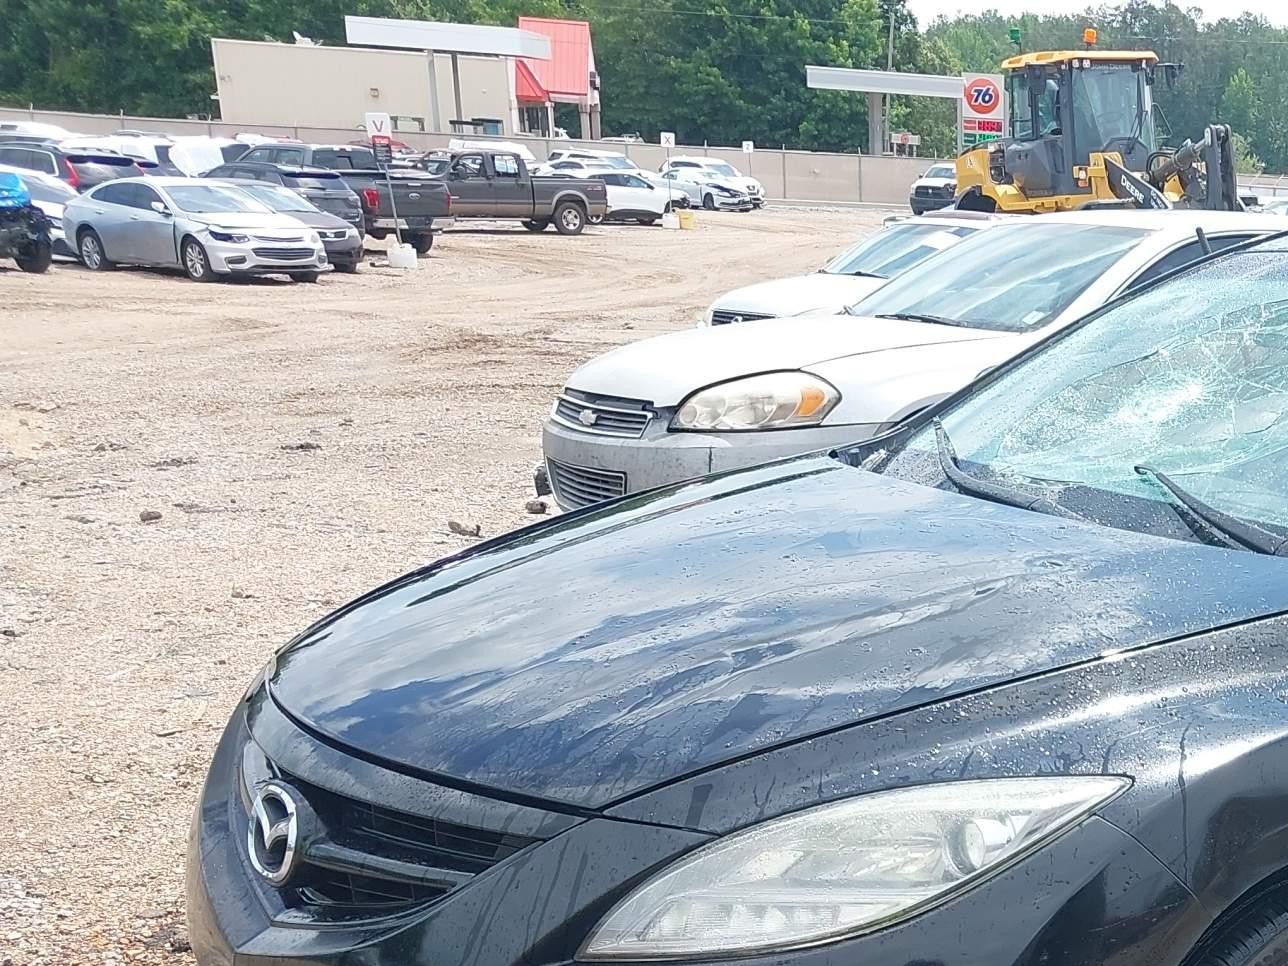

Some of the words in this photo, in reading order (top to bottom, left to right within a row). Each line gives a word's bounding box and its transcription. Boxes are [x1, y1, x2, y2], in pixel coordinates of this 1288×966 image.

[971, 86, 994, 105] 76
[372, 120, 384, 132] V
[664, 136, 671, 145] X
[1121, 175, 1144, 204] DEERE
